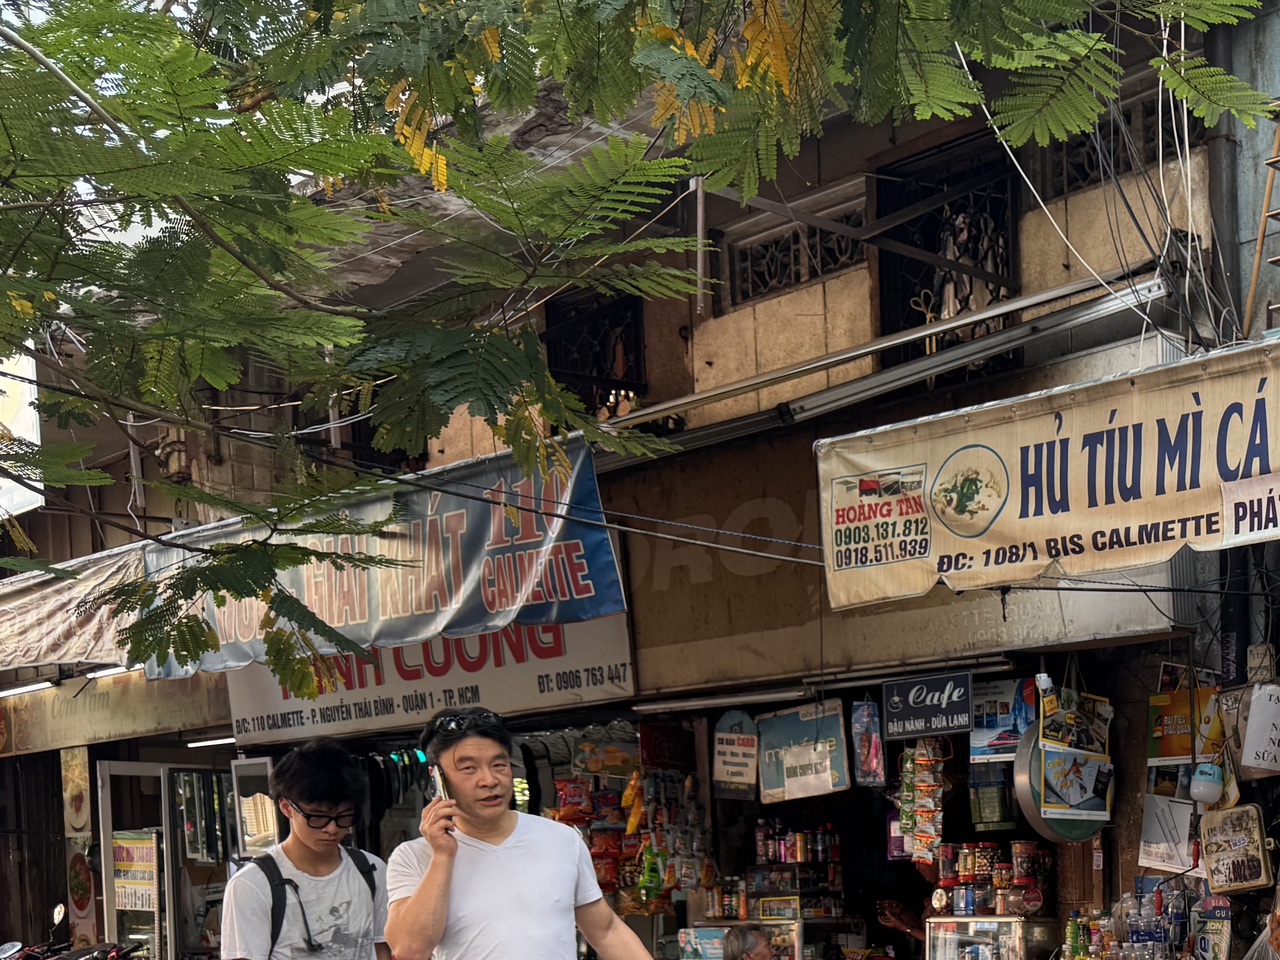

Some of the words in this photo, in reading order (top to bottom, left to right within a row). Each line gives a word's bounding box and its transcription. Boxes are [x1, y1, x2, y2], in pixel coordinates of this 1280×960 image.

[1018, 411, 1071, 519] HỦ
[1080, 408, 1143, 509] TÍU
[1154, 391, 1204, 496] MÌ
[1216, 376, 1272, 483] CÁ
[483, 465, 570, 550] 110
[835, 499, 893, 525] HOÀNG
[834, 516, 929, 547] 0903.131.812
[937, 553, 974, 574] ĐC:
[983, 541, 1040, 568] 108/1
[1046, 533, 1085, 559] BIS
[1091, 512, 1221, 552] CALMETTE
[377, 491, 467, 621] KHÁT
[835, 538, 929, 568] 0918.511.939
[480, 539, 595, 614] CALMETTE
[556, 669, 582, 691] 0906
[584, 666, 605, 687] 763
[608, 663, 628, 684] 447
[908, 680, 967, 709] Cafe
[251, 716, 265, 732] 110
[266, 709, 305, 731] CALMETTE
[311, 711, 319, 725] P.
[320, 698, 351, 724] NGUYỄN
[353, 697, 373, 719] THÁI
[374, 696, 395, 718] BÌNH
[402, 689, 427, 716] QUẬN
[429, 691, 435, 709] 1
[442, 689, 457, 707] TP.
[458, 685, 481, 706] HCM
[888, 721, 904, 737] ĐẬU
[905, 716, 926, 732] NÀNH
[931, 714, 948, 730] DỪA
[949, 712, 969, 730] LẠNH
